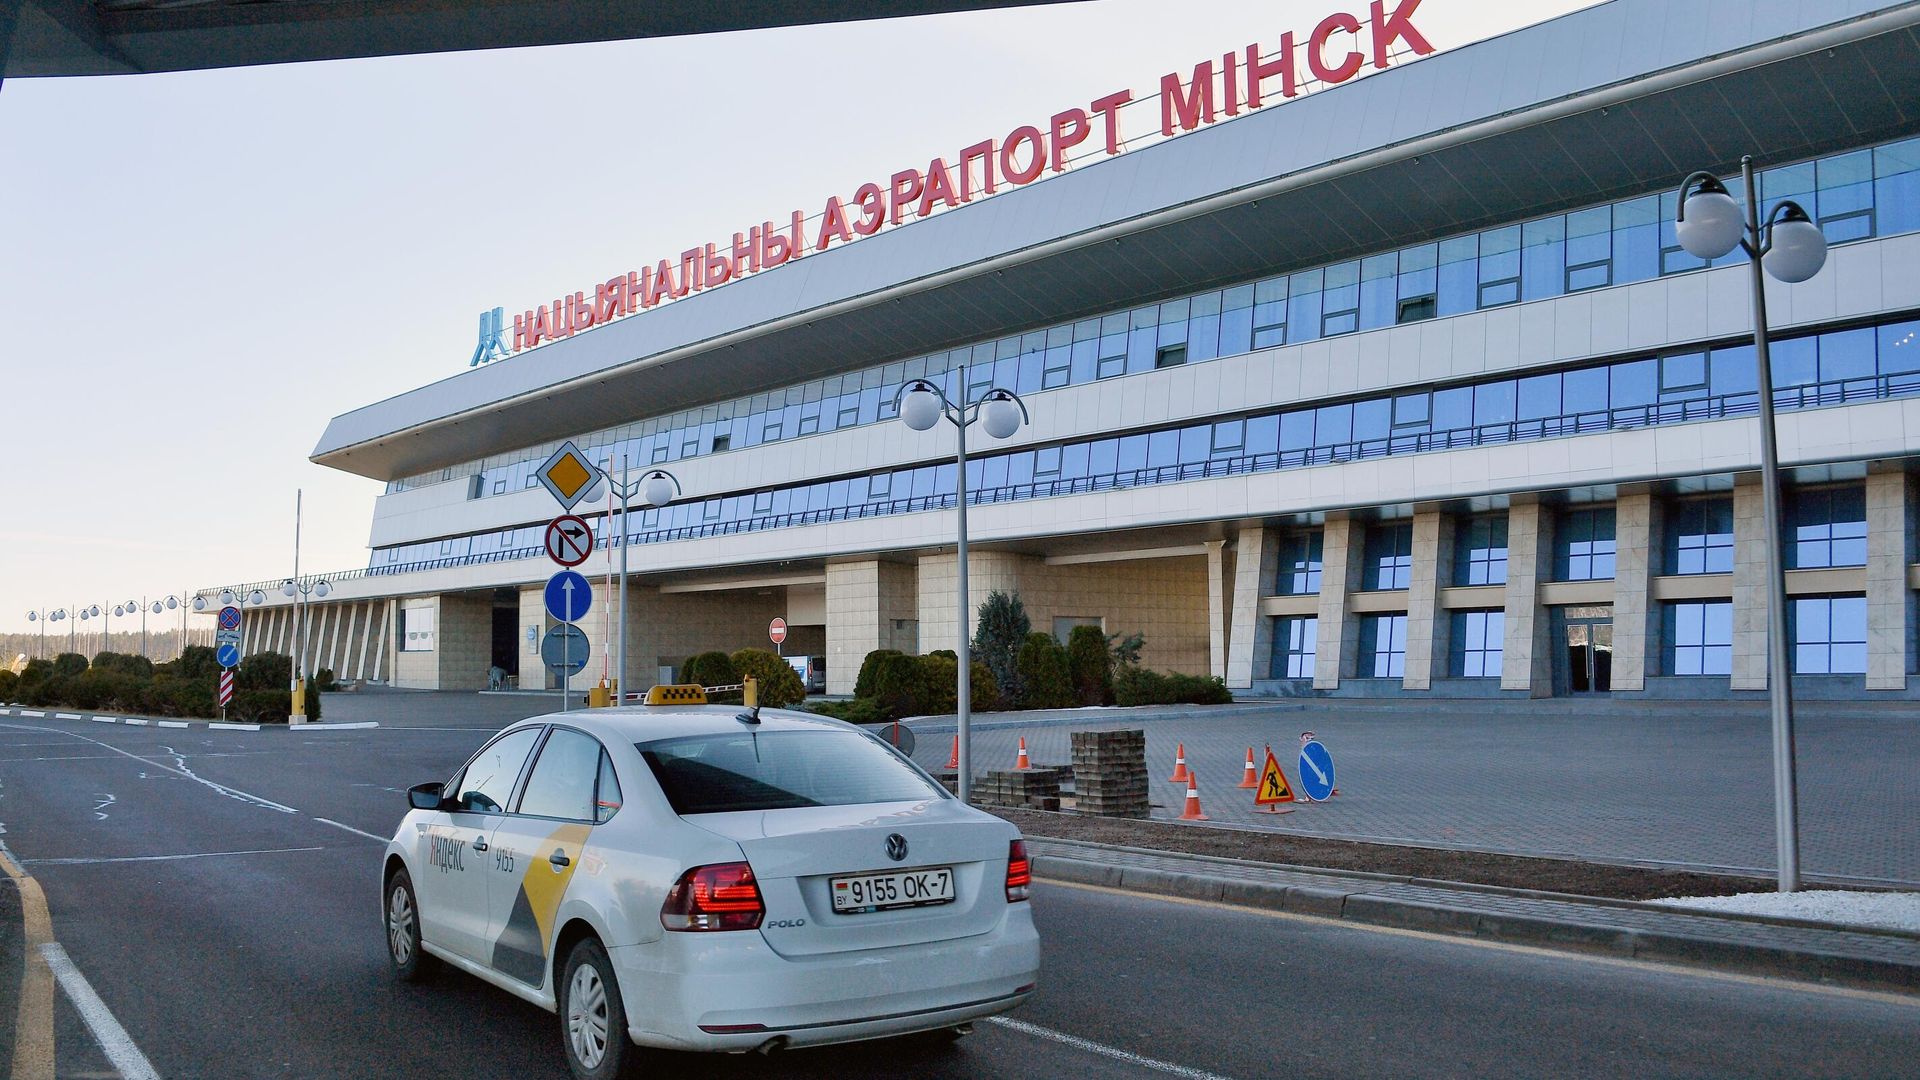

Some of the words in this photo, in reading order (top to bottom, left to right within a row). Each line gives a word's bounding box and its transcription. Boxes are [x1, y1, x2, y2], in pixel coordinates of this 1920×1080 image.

[513, 210, 804, 352] НАЦЫЯНАЛЬНЫ
[816, 89, 1134, 250] АЭРАПОРТ
[1161, 0, 1437, 137] МІНСК
[496, 847, 514, 873] 9155
[836, 895, 848, 906] BY
[852, 878, 897, 904] 9155
[903, 872, 948, 899] OK-7
[767, 918, 806, 930] POLO
